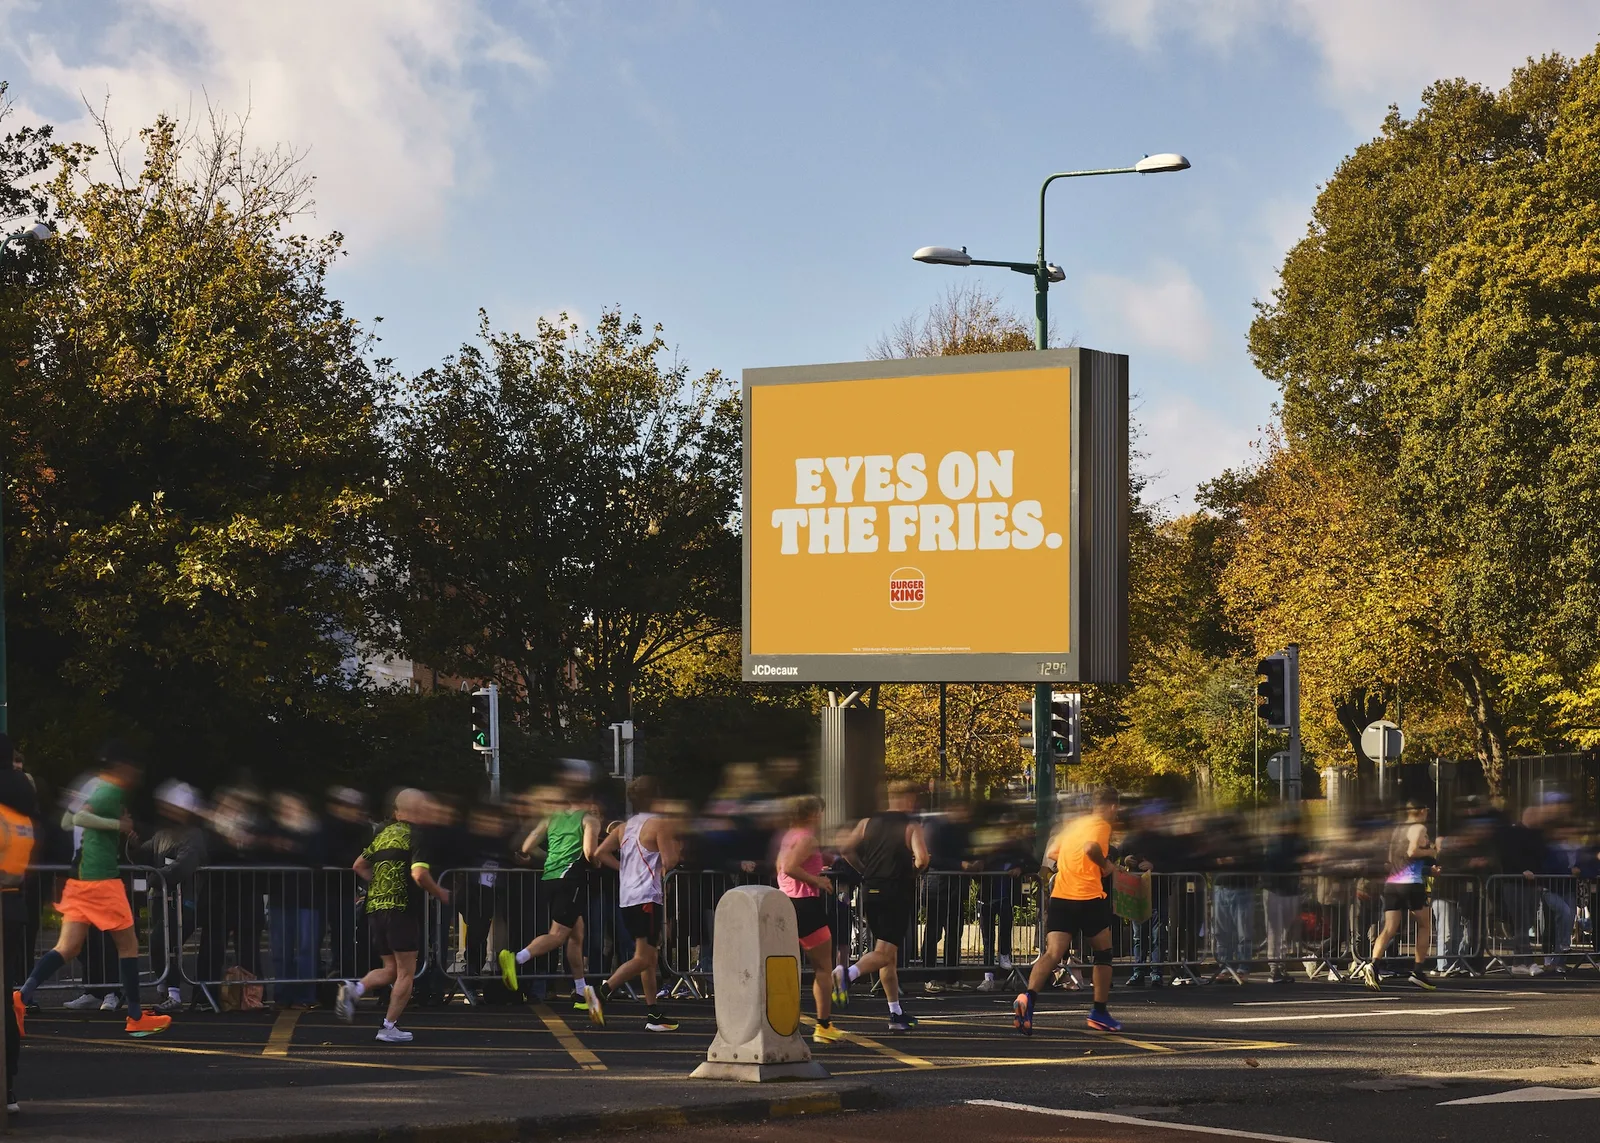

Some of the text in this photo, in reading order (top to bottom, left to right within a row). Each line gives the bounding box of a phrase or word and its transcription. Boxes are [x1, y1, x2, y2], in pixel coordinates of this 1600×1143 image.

[795, 450, 1014, 504] EYES ON
[772, 500, 1062, 554] THE FRIES.
[891, 580, 924, 589] BURGER
[891, 589, 924, 601] KING
[752, 664, 798, 675] JCDecaux
